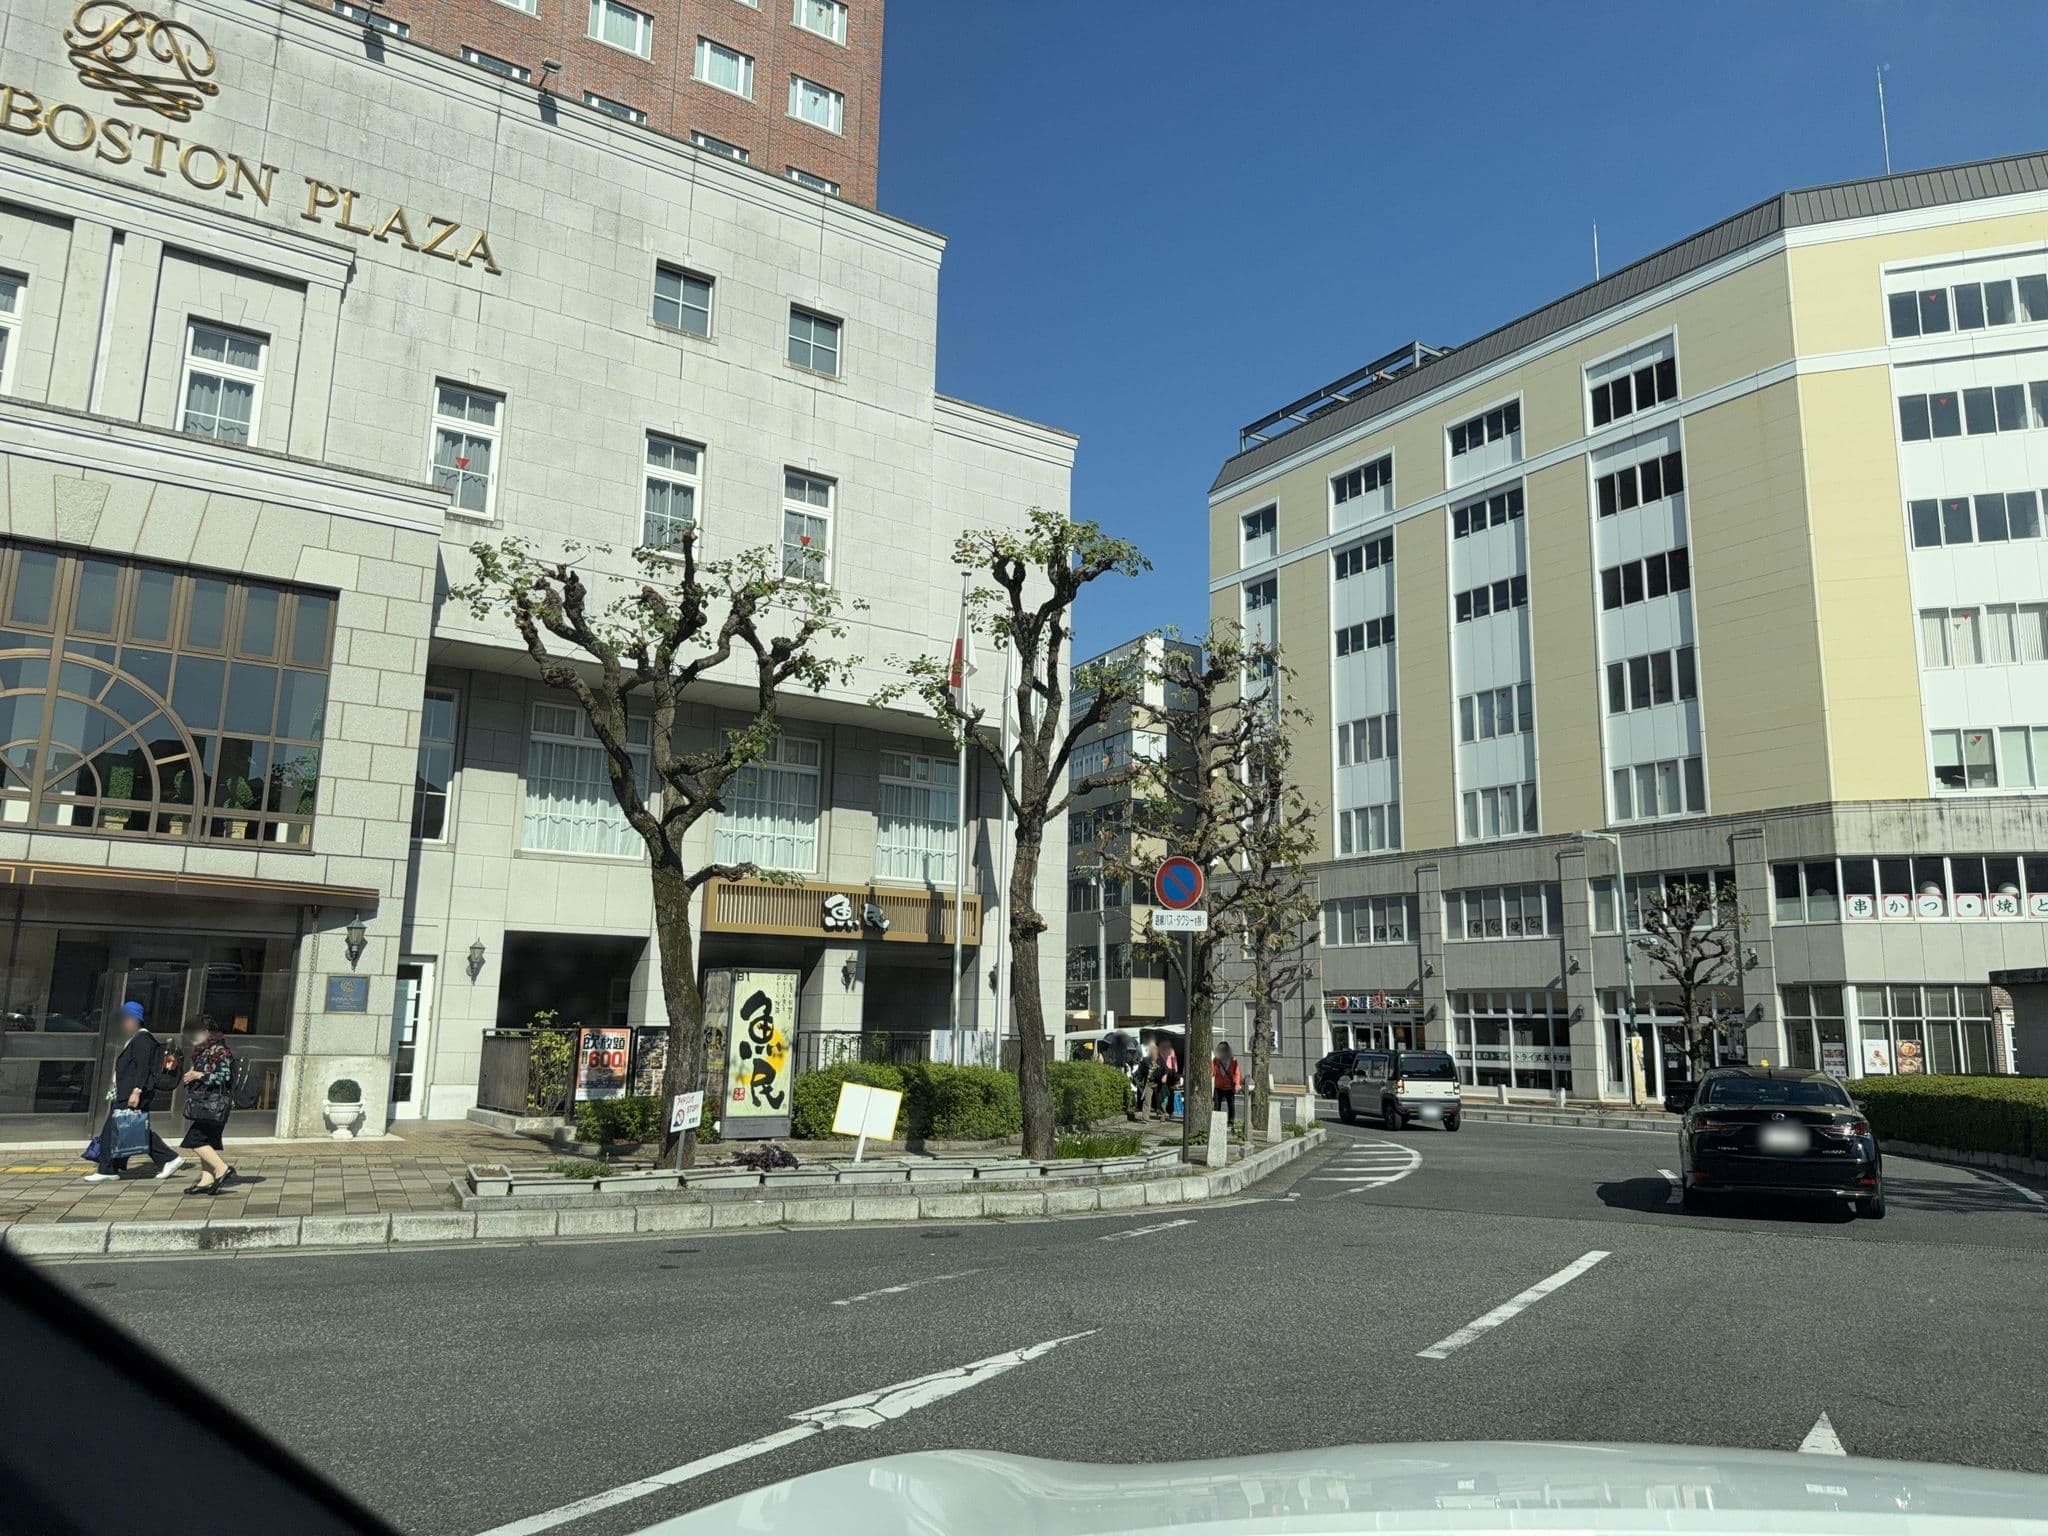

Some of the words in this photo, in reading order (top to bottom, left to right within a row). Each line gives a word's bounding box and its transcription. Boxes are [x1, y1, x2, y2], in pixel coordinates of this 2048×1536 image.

[0, 84, 280, 207] BOSTON
[300, 176, 502, 275] PLAZA
[824, 893, 890, 930] 魚民
[588, 1050, 624, 1068] 600
[739, 989, 785, 1110] 魚民
